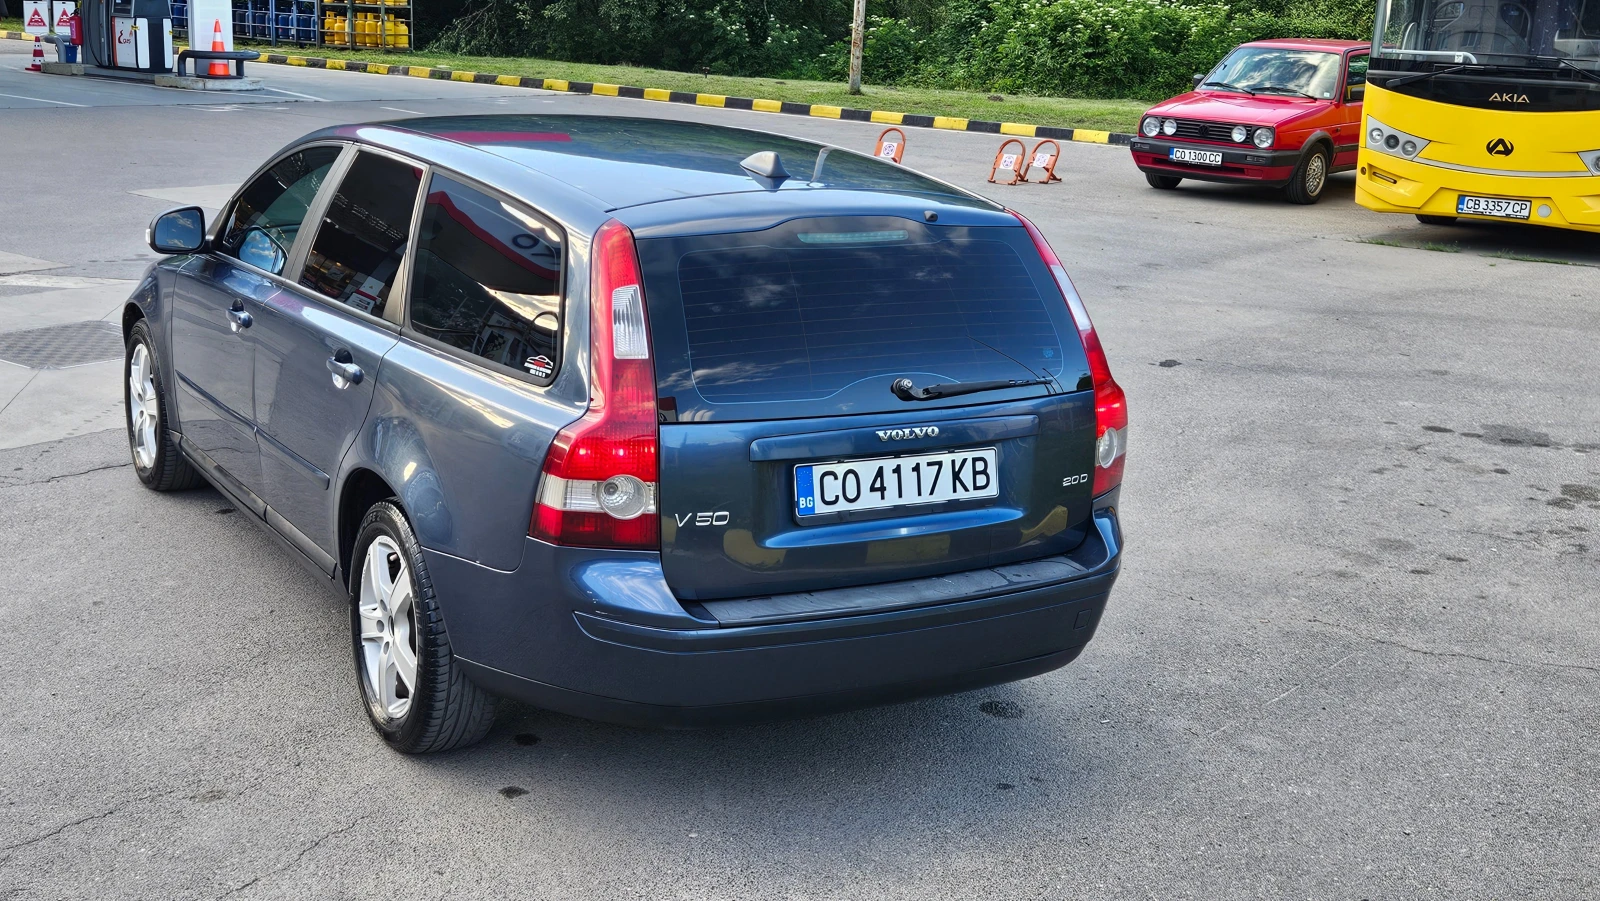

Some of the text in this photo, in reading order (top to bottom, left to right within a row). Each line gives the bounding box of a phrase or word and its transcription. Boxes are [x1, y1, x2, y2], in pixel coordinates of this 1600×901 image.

[1488, 92, 1530, 104] AKIA
[1174, 149, 1221, 163] CO 1300 CC
[1465, 198, 1481, 210] CB
[1482, 200, 1511, 213] 3357
[1511, 202, 1528, 214] CP
[875, 425, 940, 442] VOLVO
[819, 456, 991, 506] CO 4117 KB
[799, 496, 814, 509] BG
